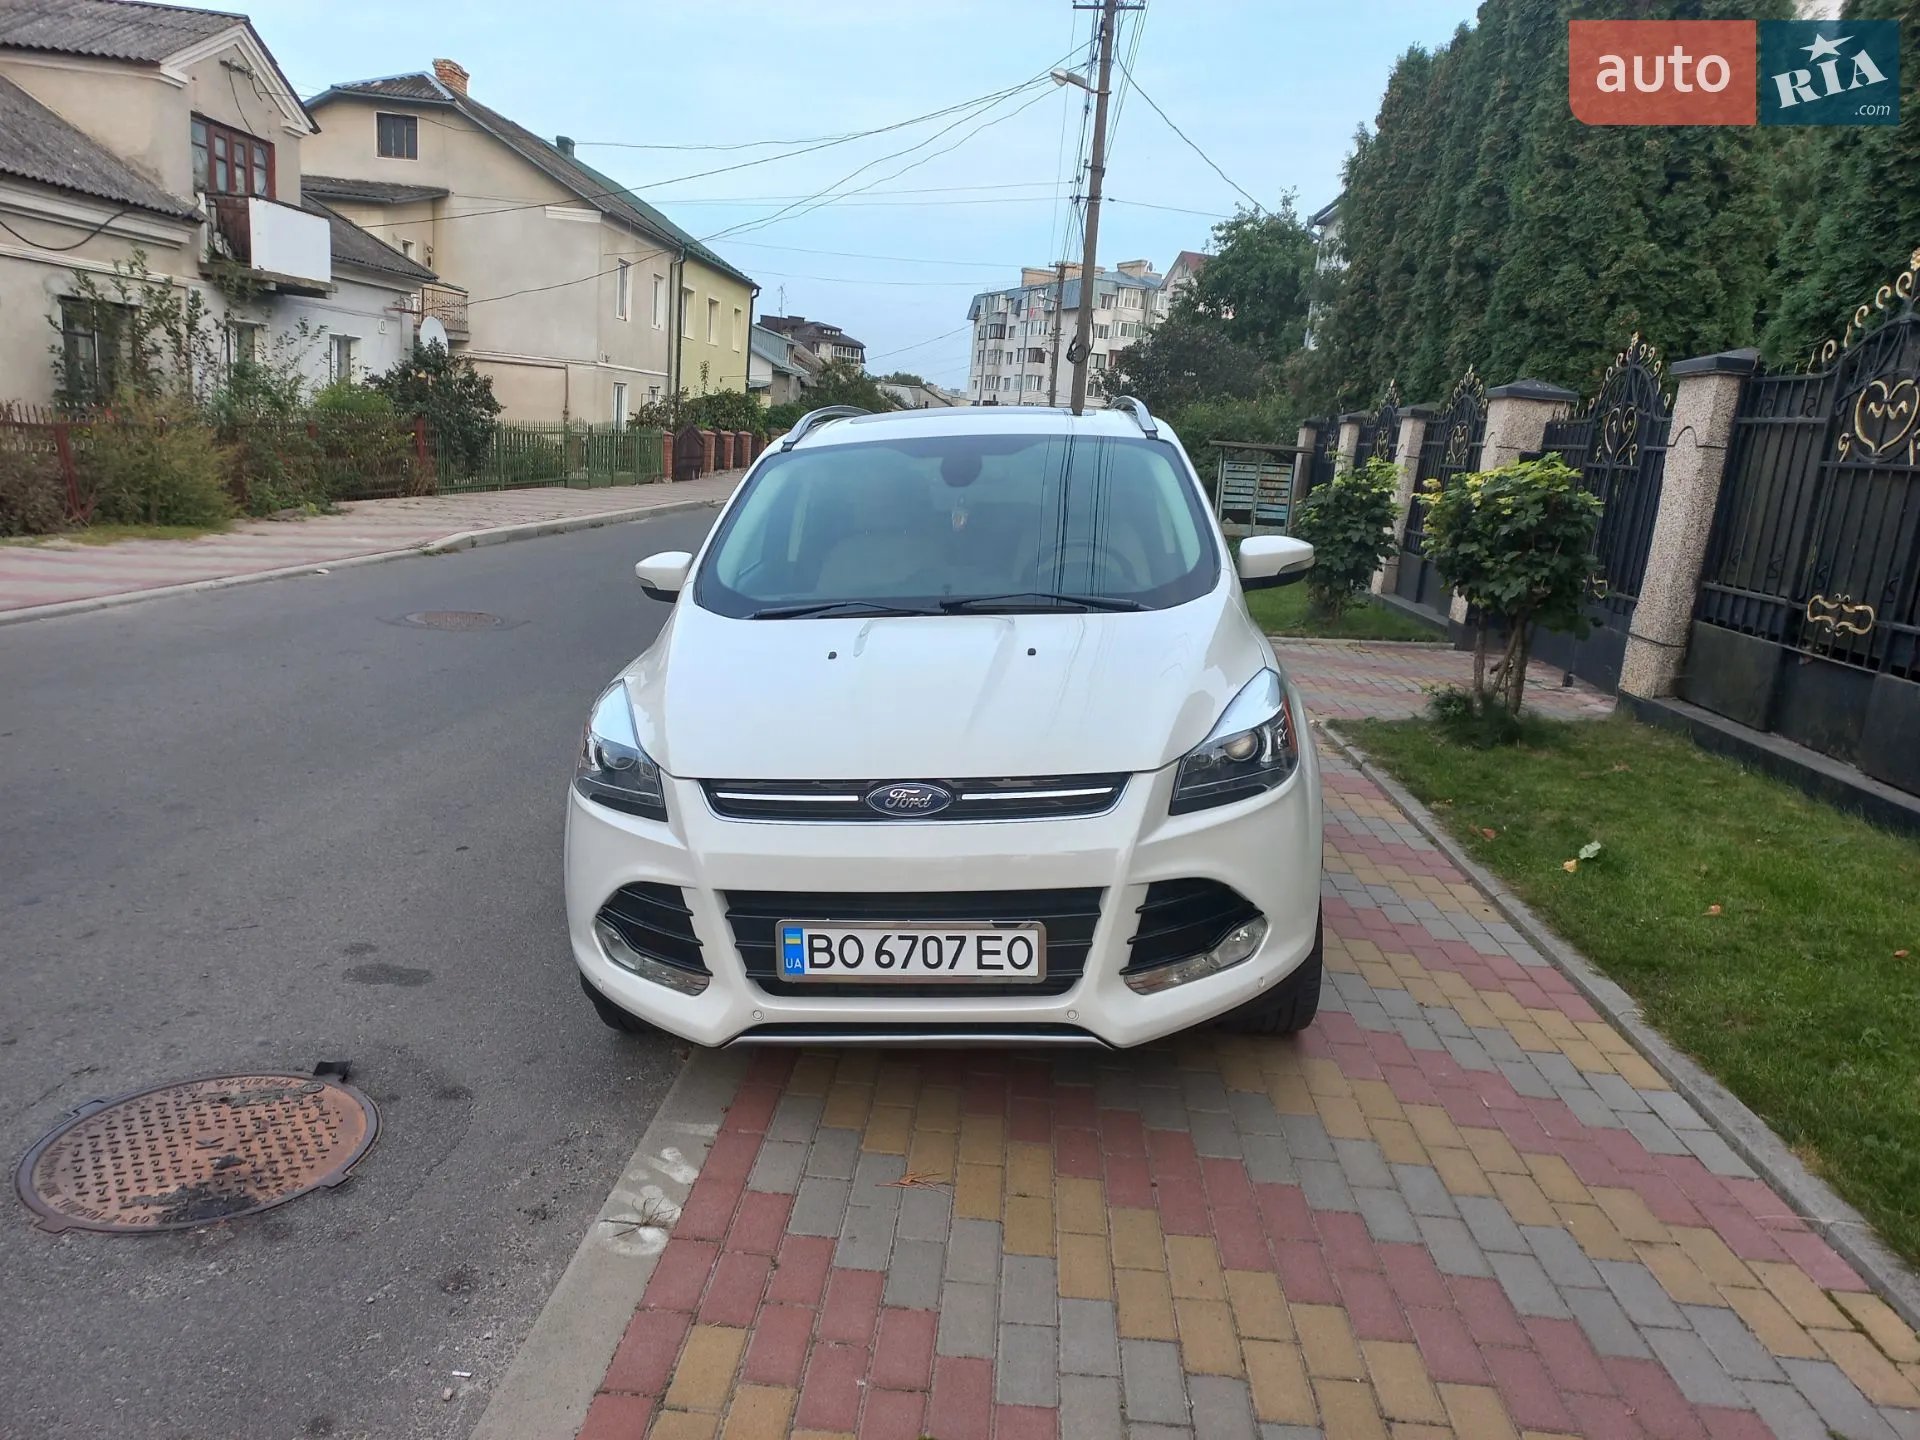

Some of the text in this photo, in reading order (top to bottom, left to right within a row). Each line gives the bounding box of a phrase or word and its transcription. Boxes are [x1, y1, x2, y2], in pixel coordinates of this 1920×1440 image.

[884, 788, 933, 809] Ford
[807, 934, 1034, 970] BO 6707 EO
[785, 958, 802, 969] UA
